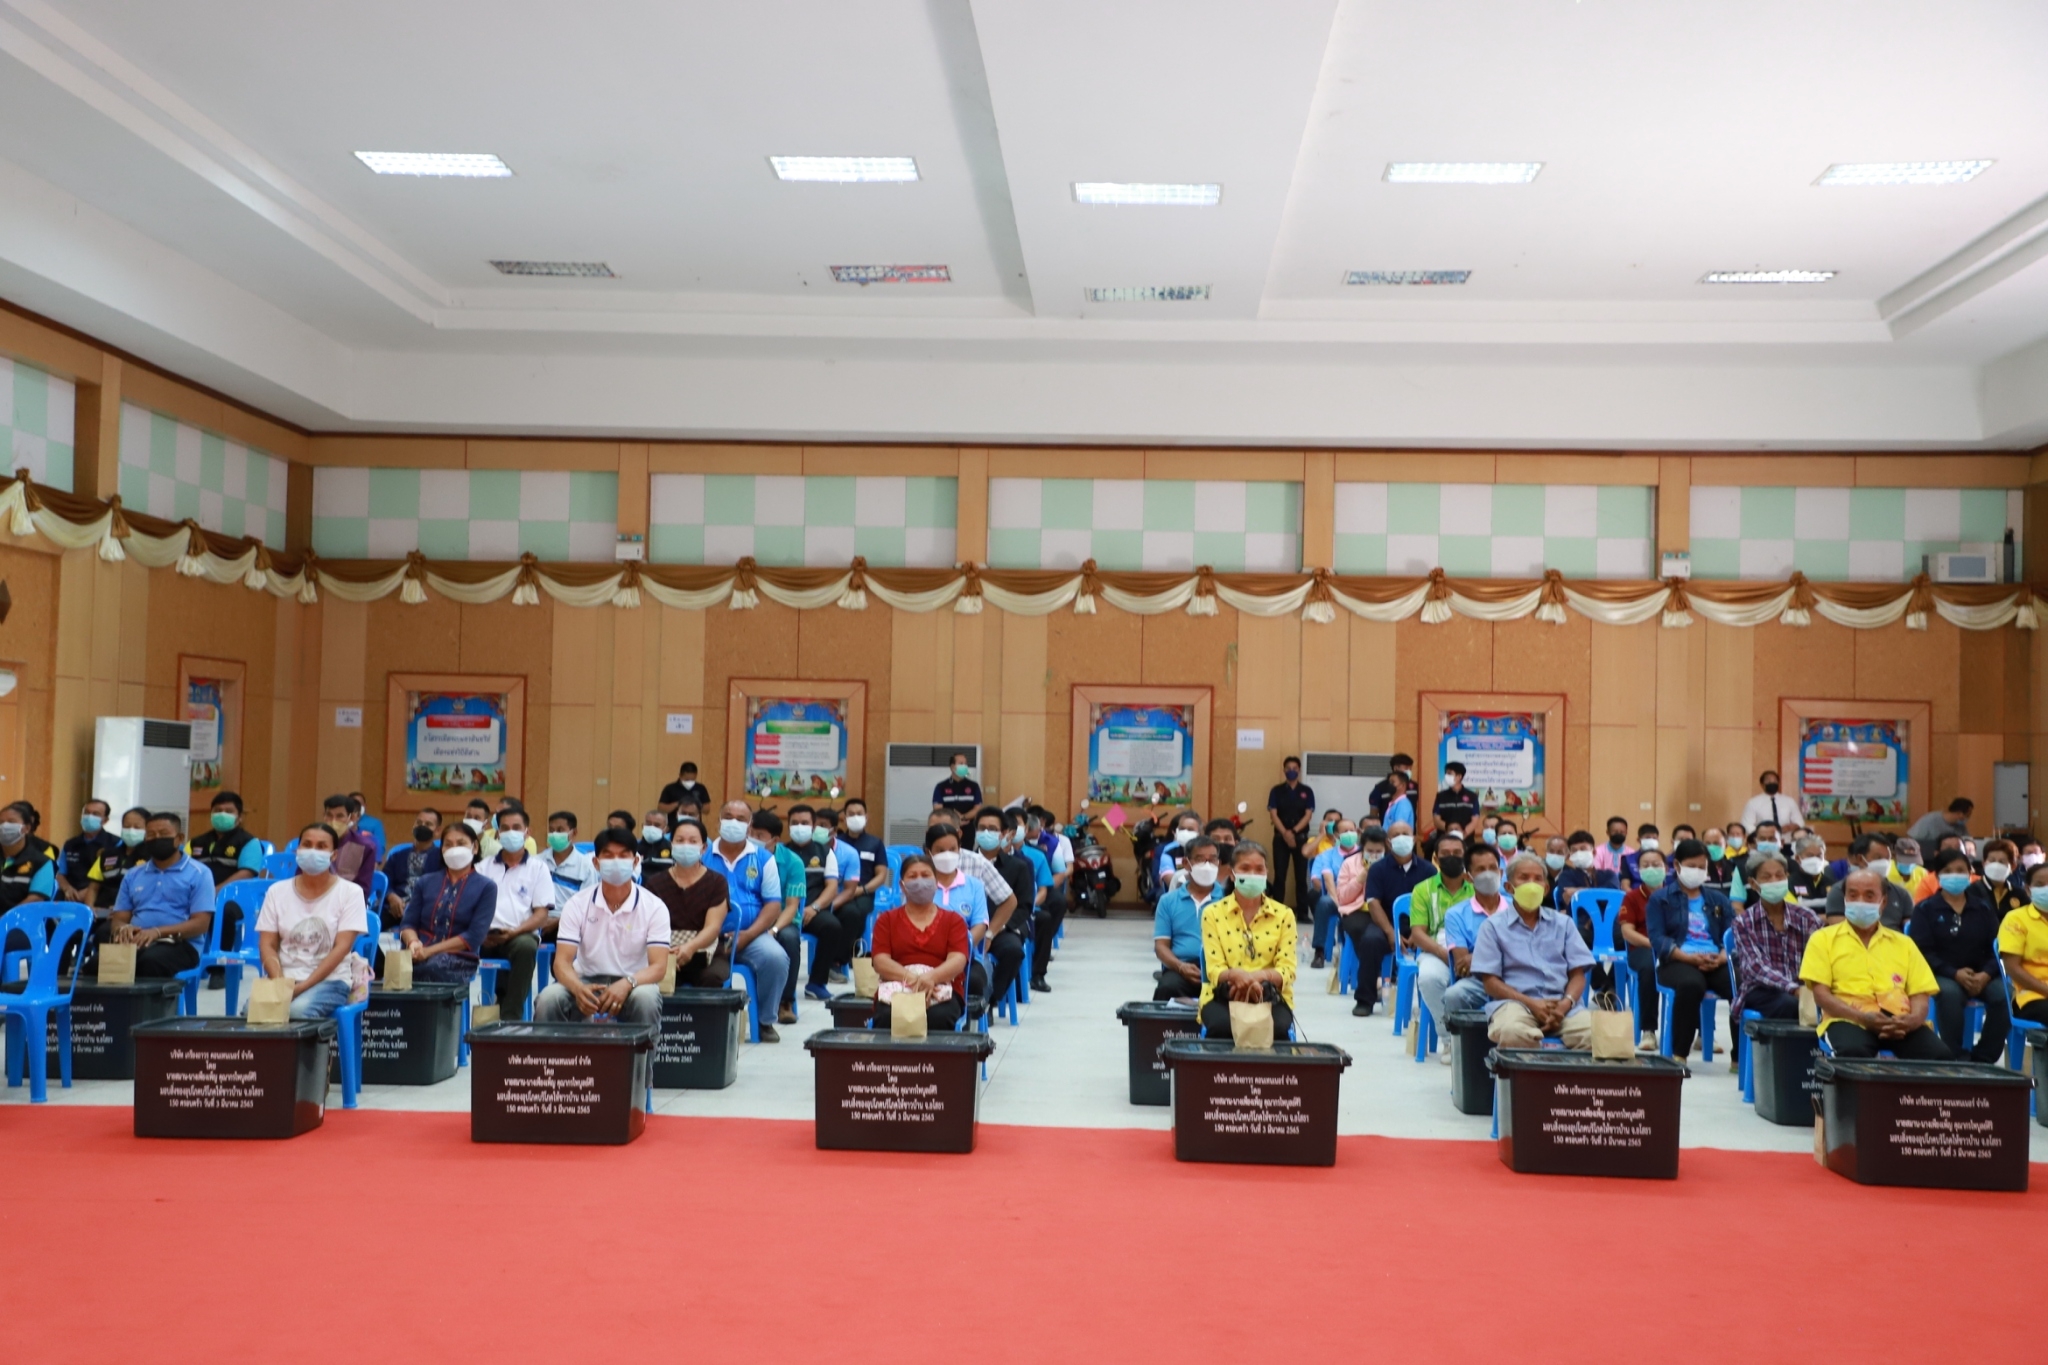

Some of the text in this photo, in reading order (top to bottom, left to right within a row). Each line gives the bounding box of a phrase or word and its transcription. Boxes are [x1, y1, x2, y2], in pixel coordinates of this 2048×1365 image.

[390, 1009, 401, 1018] จำกัด
[170, 1050, 184, 1060] บริษัท
[241, 1050, 253, 1060] จำกัด
[372, 1050, 386, 1058] มีนาคม
[388, 1051, 399, 1059] 2565
[206, 1061, 216, 1070] โดย
[508, 1055, 521, 1065] บริษัท
[579, 1055, 591, 1066] จำกัด
[544, 1066, 554, 1076] โดย
[852, 1062, 865, 1072] บริษัท
[922, 1063, 934, 1073] จำกัด
[888, 1073, 898, 1083] โดย
[1161, 1072, 1169, 1080] 150
[1214, 1074, 1227, 1084] บริษัท
[1286, 1075, 1298, 1085] จำกัด
[1251, 1085, 1261, 1095] โดย
[1554, 1084, 1568, 1095] บริษัท
[1629, 1086, 1641, 1097] จำกัด
[180, 1099, 202, 1108] ครอบครัว
[204, 1097, 215, 1108] วันที่
[216, 1100, 219, 1108] 3
[221, 1099, 238, 1108] มีนาคม
[240, 1100, 253, 1108] 2565
[1593, 1096, 1604, 1106] โดย
[1899, 1095, 1914, 1107] บริษัท
[1976, 1097, 1989, 1108] จำกัด
[507, 1105, 516, 1113] 150
[517, 1104, 539, 1113] ครอบครัว
[542, 1102, 552, 1113] วันที่
[558, 1105, 575, 1114] มีนาคม
[577, 1106, 590, 1114] 2565
[1940, 1107, 1950, 1117] โดย
[851, 1109, 934, 1122] 150 ครอบครัว วันที่ 3 มีนาคม 2565
[1214, 1121, 1299, 1134] 150 ครอบครัว วันที่ 3 มีนาคม 2565
[1553, 1133, 1641, 1146] 150 ครอบครัว วันที่ 3 มีนาคม 2565
[1901, 1144, 1991, 1158] 150 ครอบครัว วันที่ 3 มีนาคม 2565
